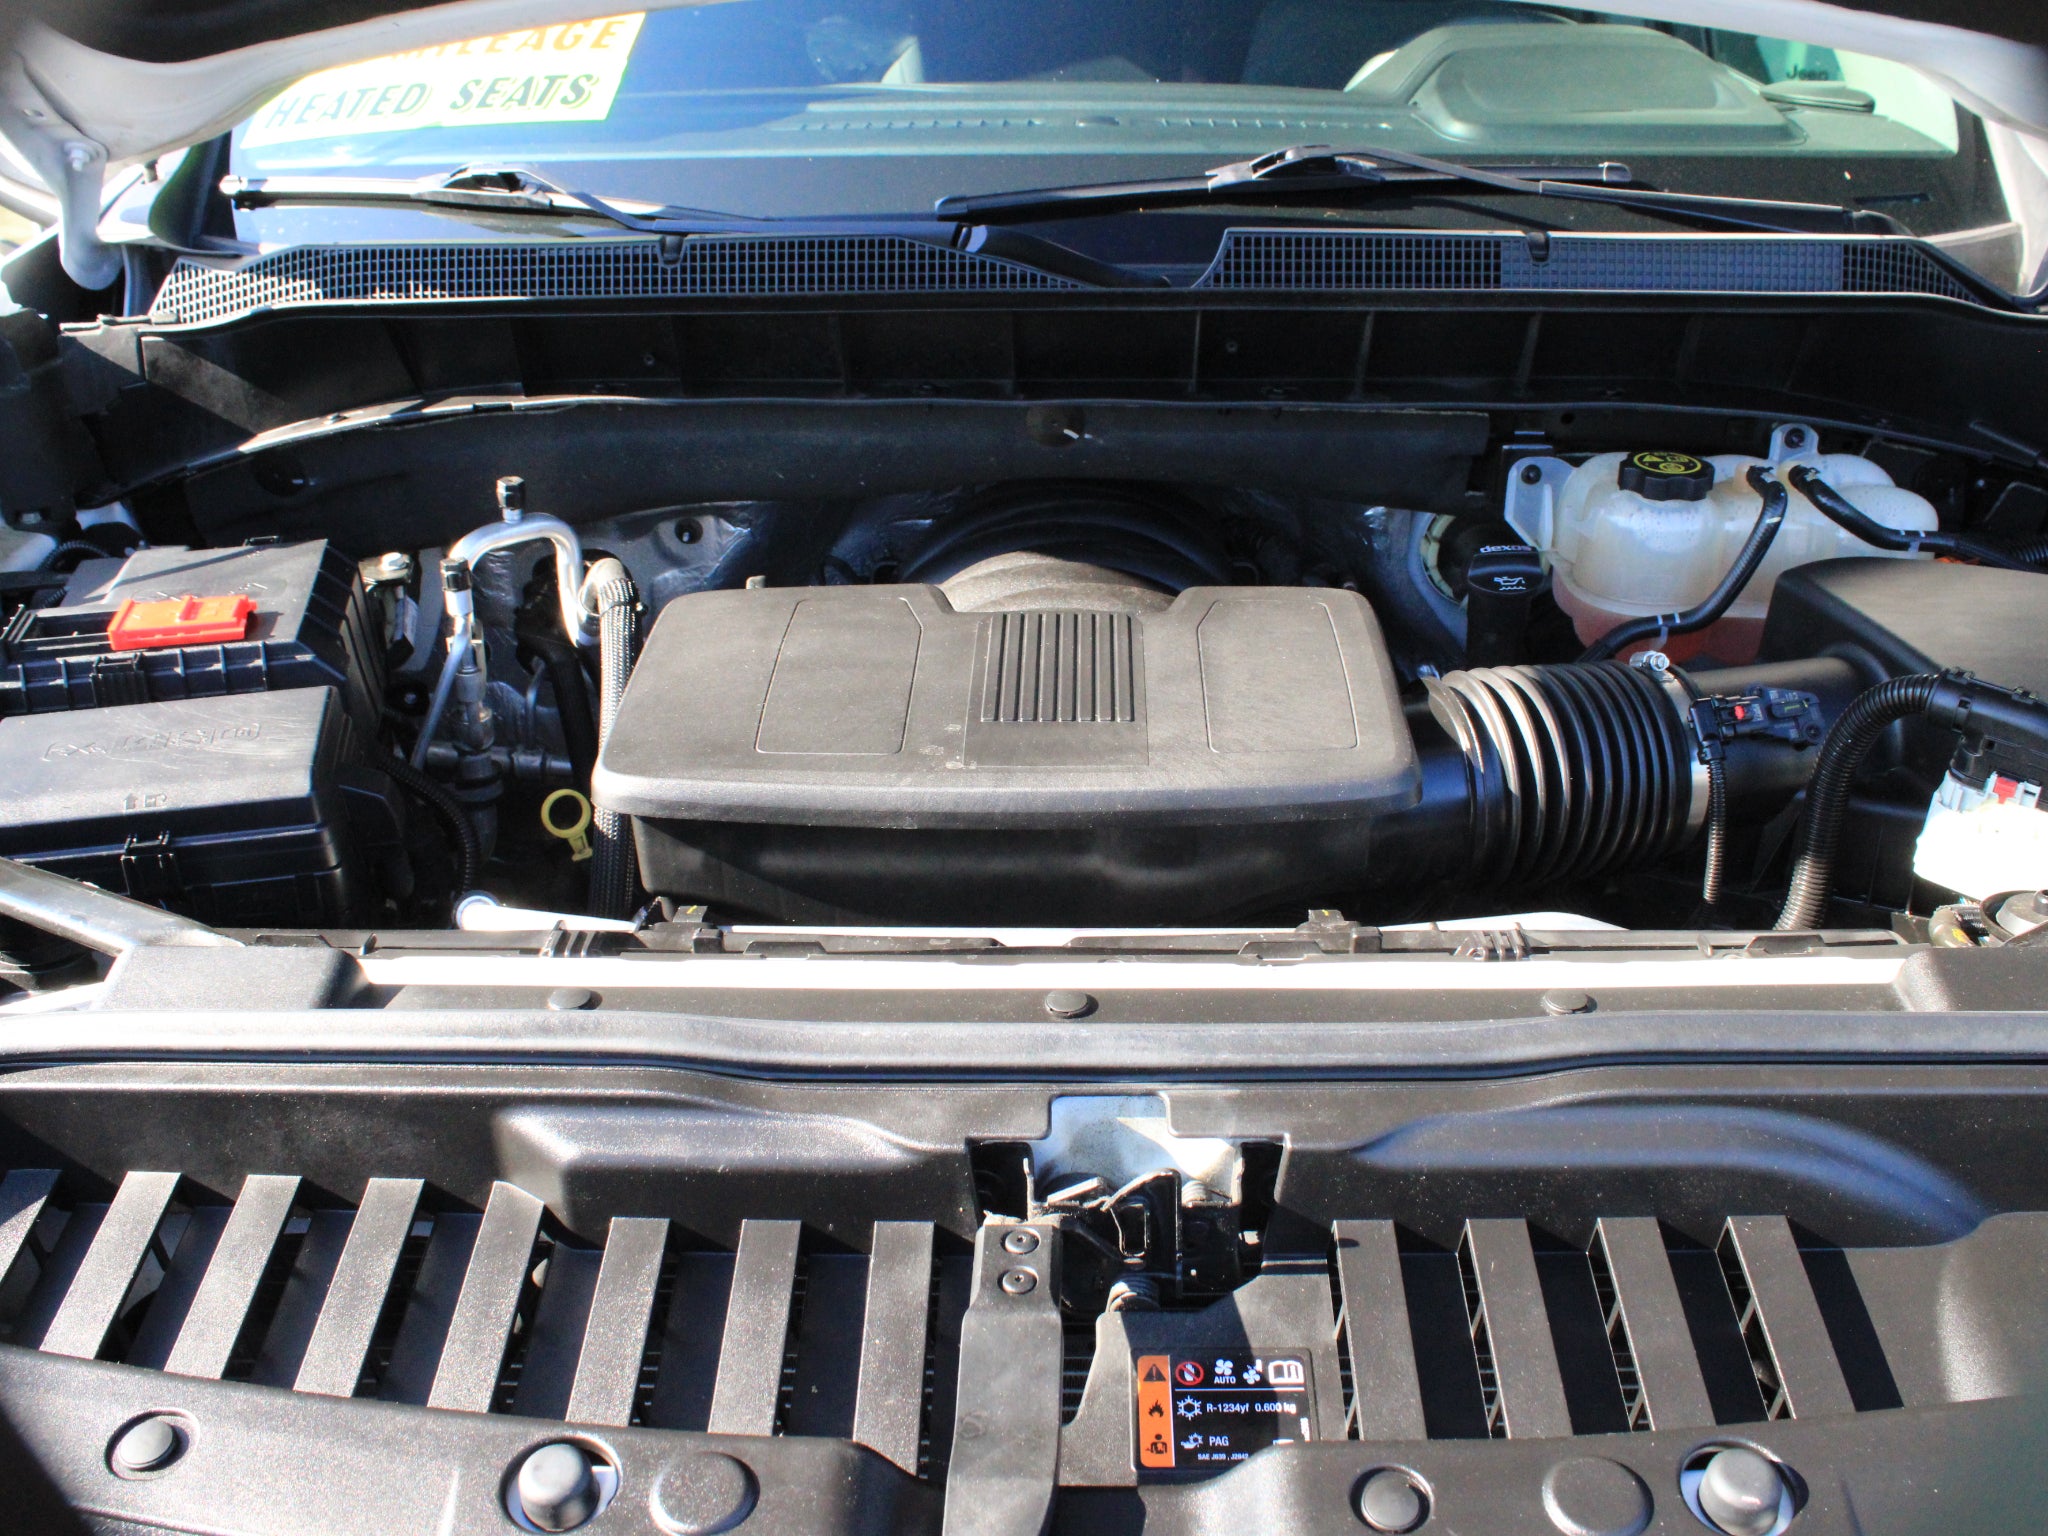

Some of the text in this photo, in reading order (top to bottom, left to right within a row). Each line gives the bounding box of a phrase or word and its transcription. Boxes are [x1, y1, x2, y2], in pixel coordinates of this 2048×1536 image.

[264, 74, 599, 128] HEATED SEATS
[1214, 1376, 1236, 1384] AUTO
[1206, 1402, 1249, 1414] R-1234yf
[1254, 1402, 1283, 1413] 0.600
[1209, 1436, 1229, 1447] PAG
